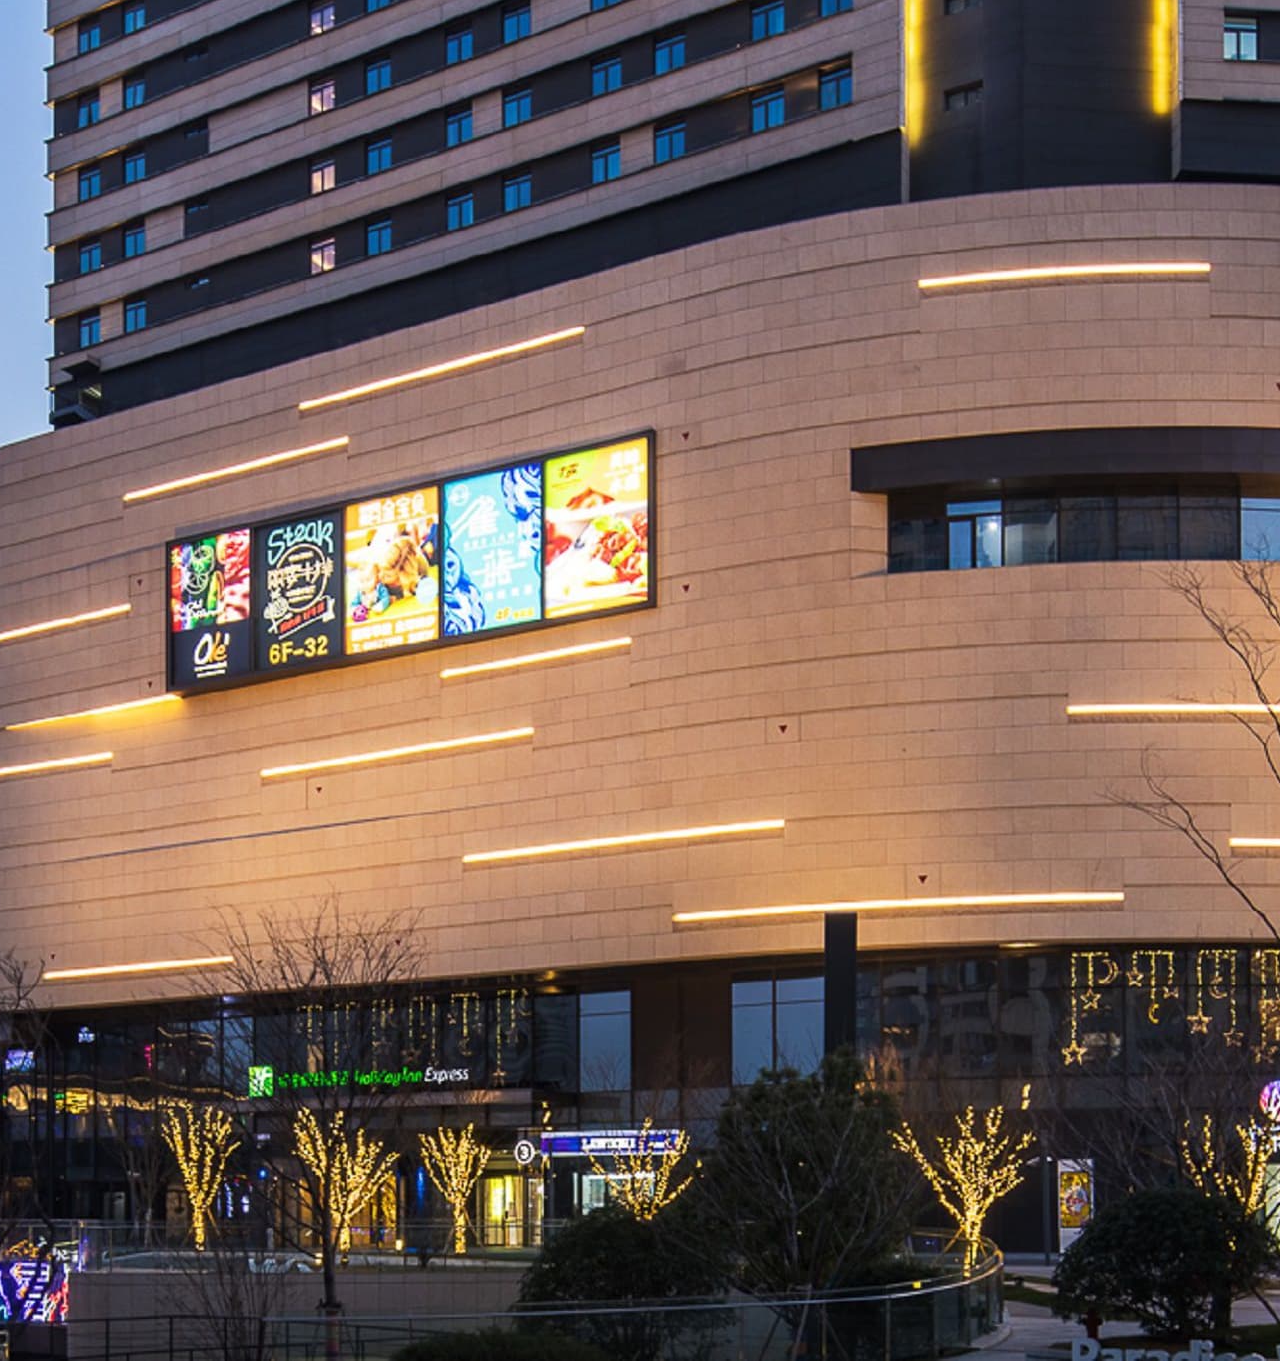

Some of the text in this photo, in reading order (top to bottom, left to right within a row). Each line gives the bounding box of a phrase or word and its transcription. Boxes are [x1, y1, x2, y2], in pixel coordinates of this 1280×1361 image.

[267, 519, 334, 565] Steak
[269, 635, 329, 665] 6F-32
[424, 1066, 469, 1085] Express
[519, 1145, 530, 1160] 3
